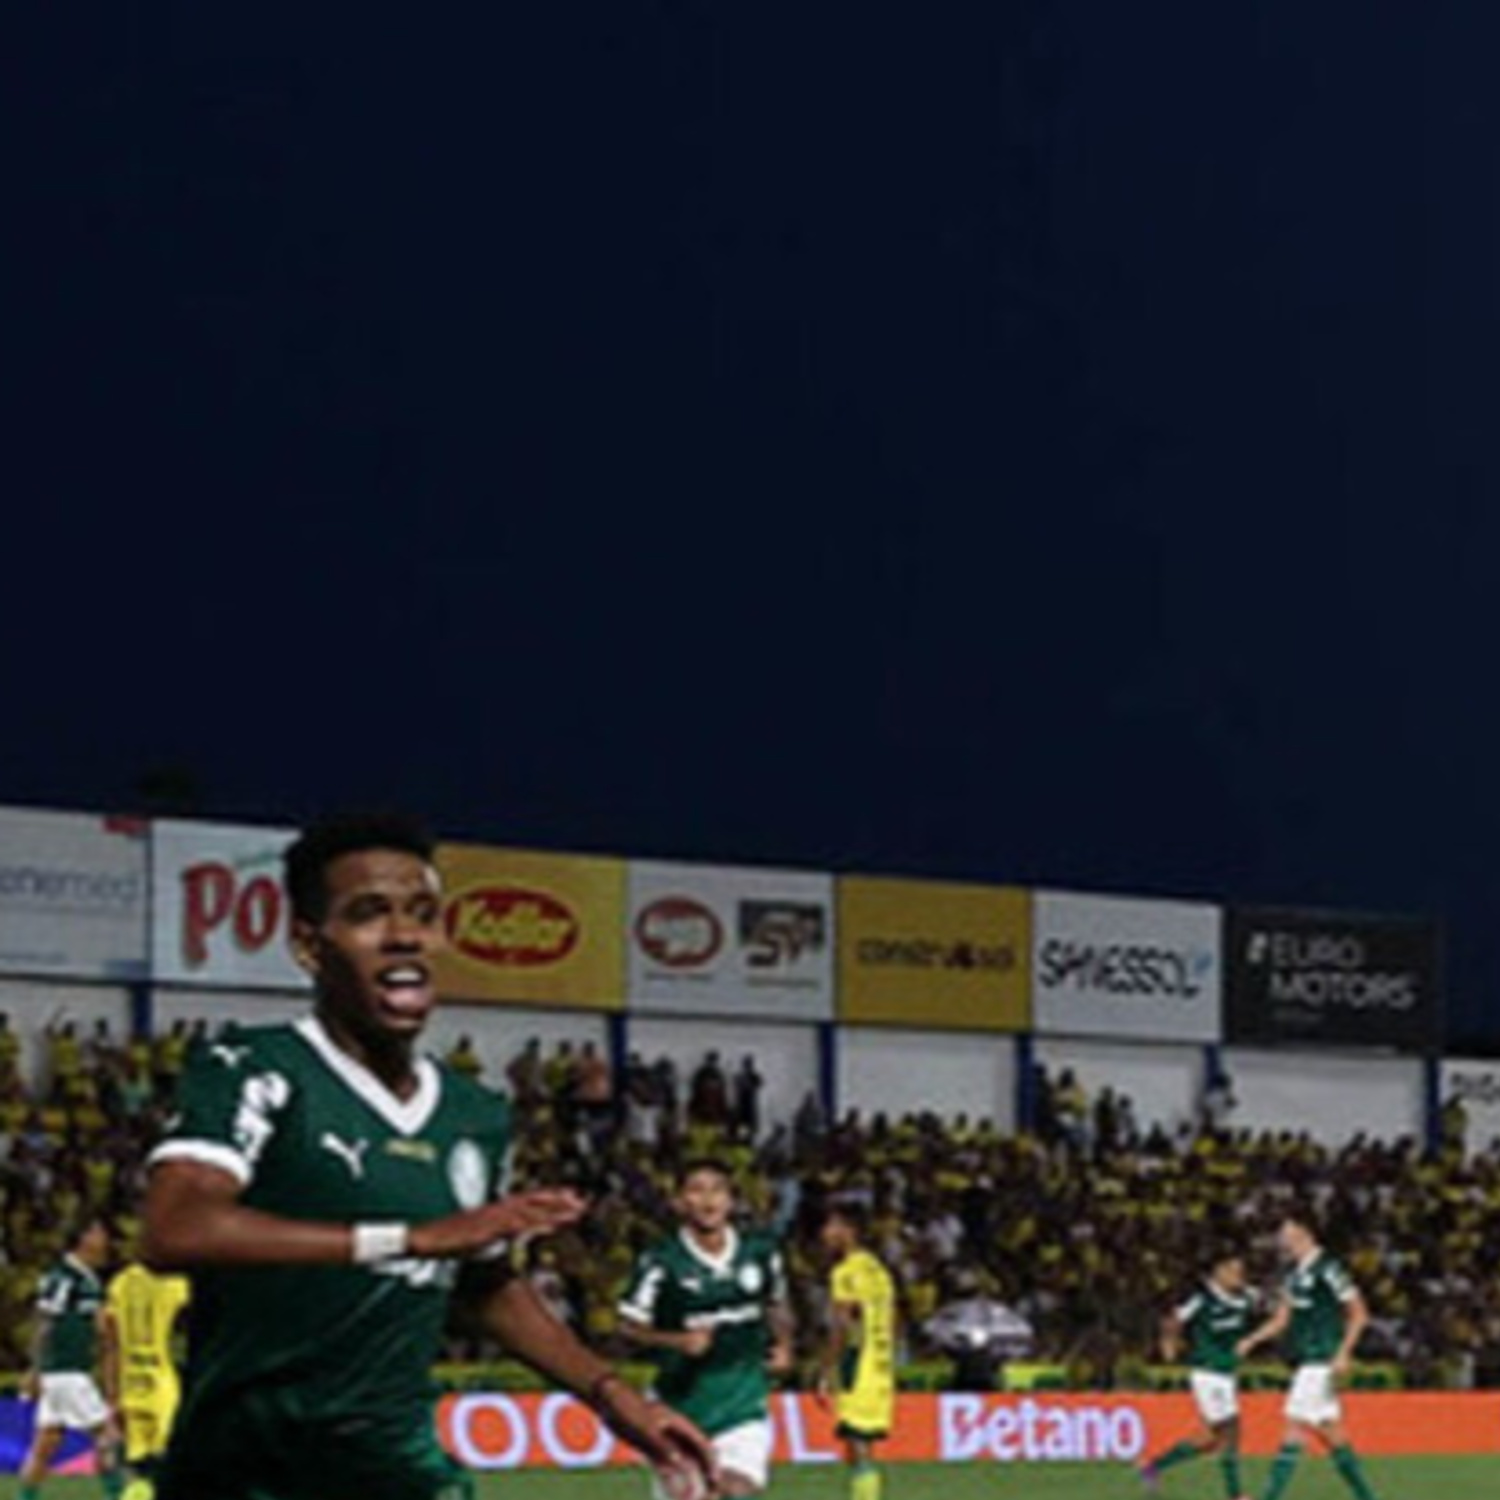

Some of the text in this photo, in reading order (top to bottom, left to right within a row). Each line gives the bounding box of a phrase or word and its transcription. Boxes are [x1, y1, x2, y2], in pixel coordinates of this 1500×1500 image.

[1271, 932, 1365, 968] EURO
[1271, 972, 1417, 1010] MOTORS
[940, 1392, 1145, 1460] Betano
